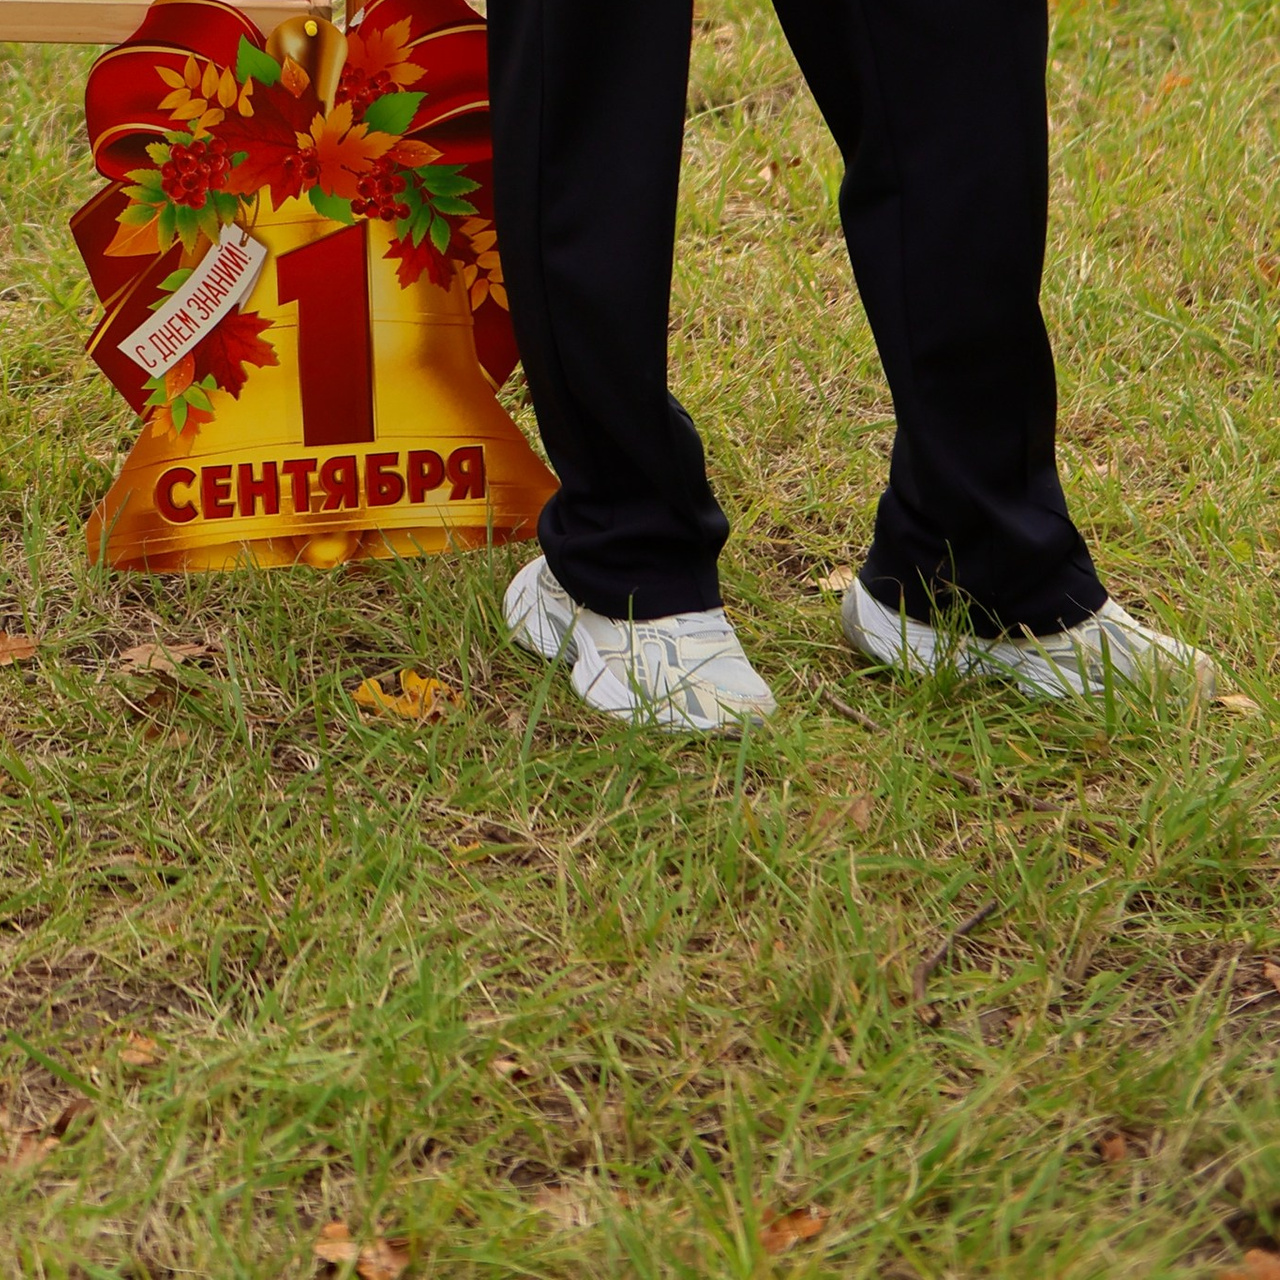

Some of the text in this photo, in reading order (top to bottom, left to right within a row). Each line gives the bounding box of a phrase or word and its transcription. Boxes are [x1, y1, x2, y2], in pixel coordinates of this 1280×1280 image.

[135, 241, 252, 368] С ДНЕМ ЗНАНИЙ!
[276, 221, 375, 446] 1
[154, 445, 487, 524] СЕНТЯБРЯ
